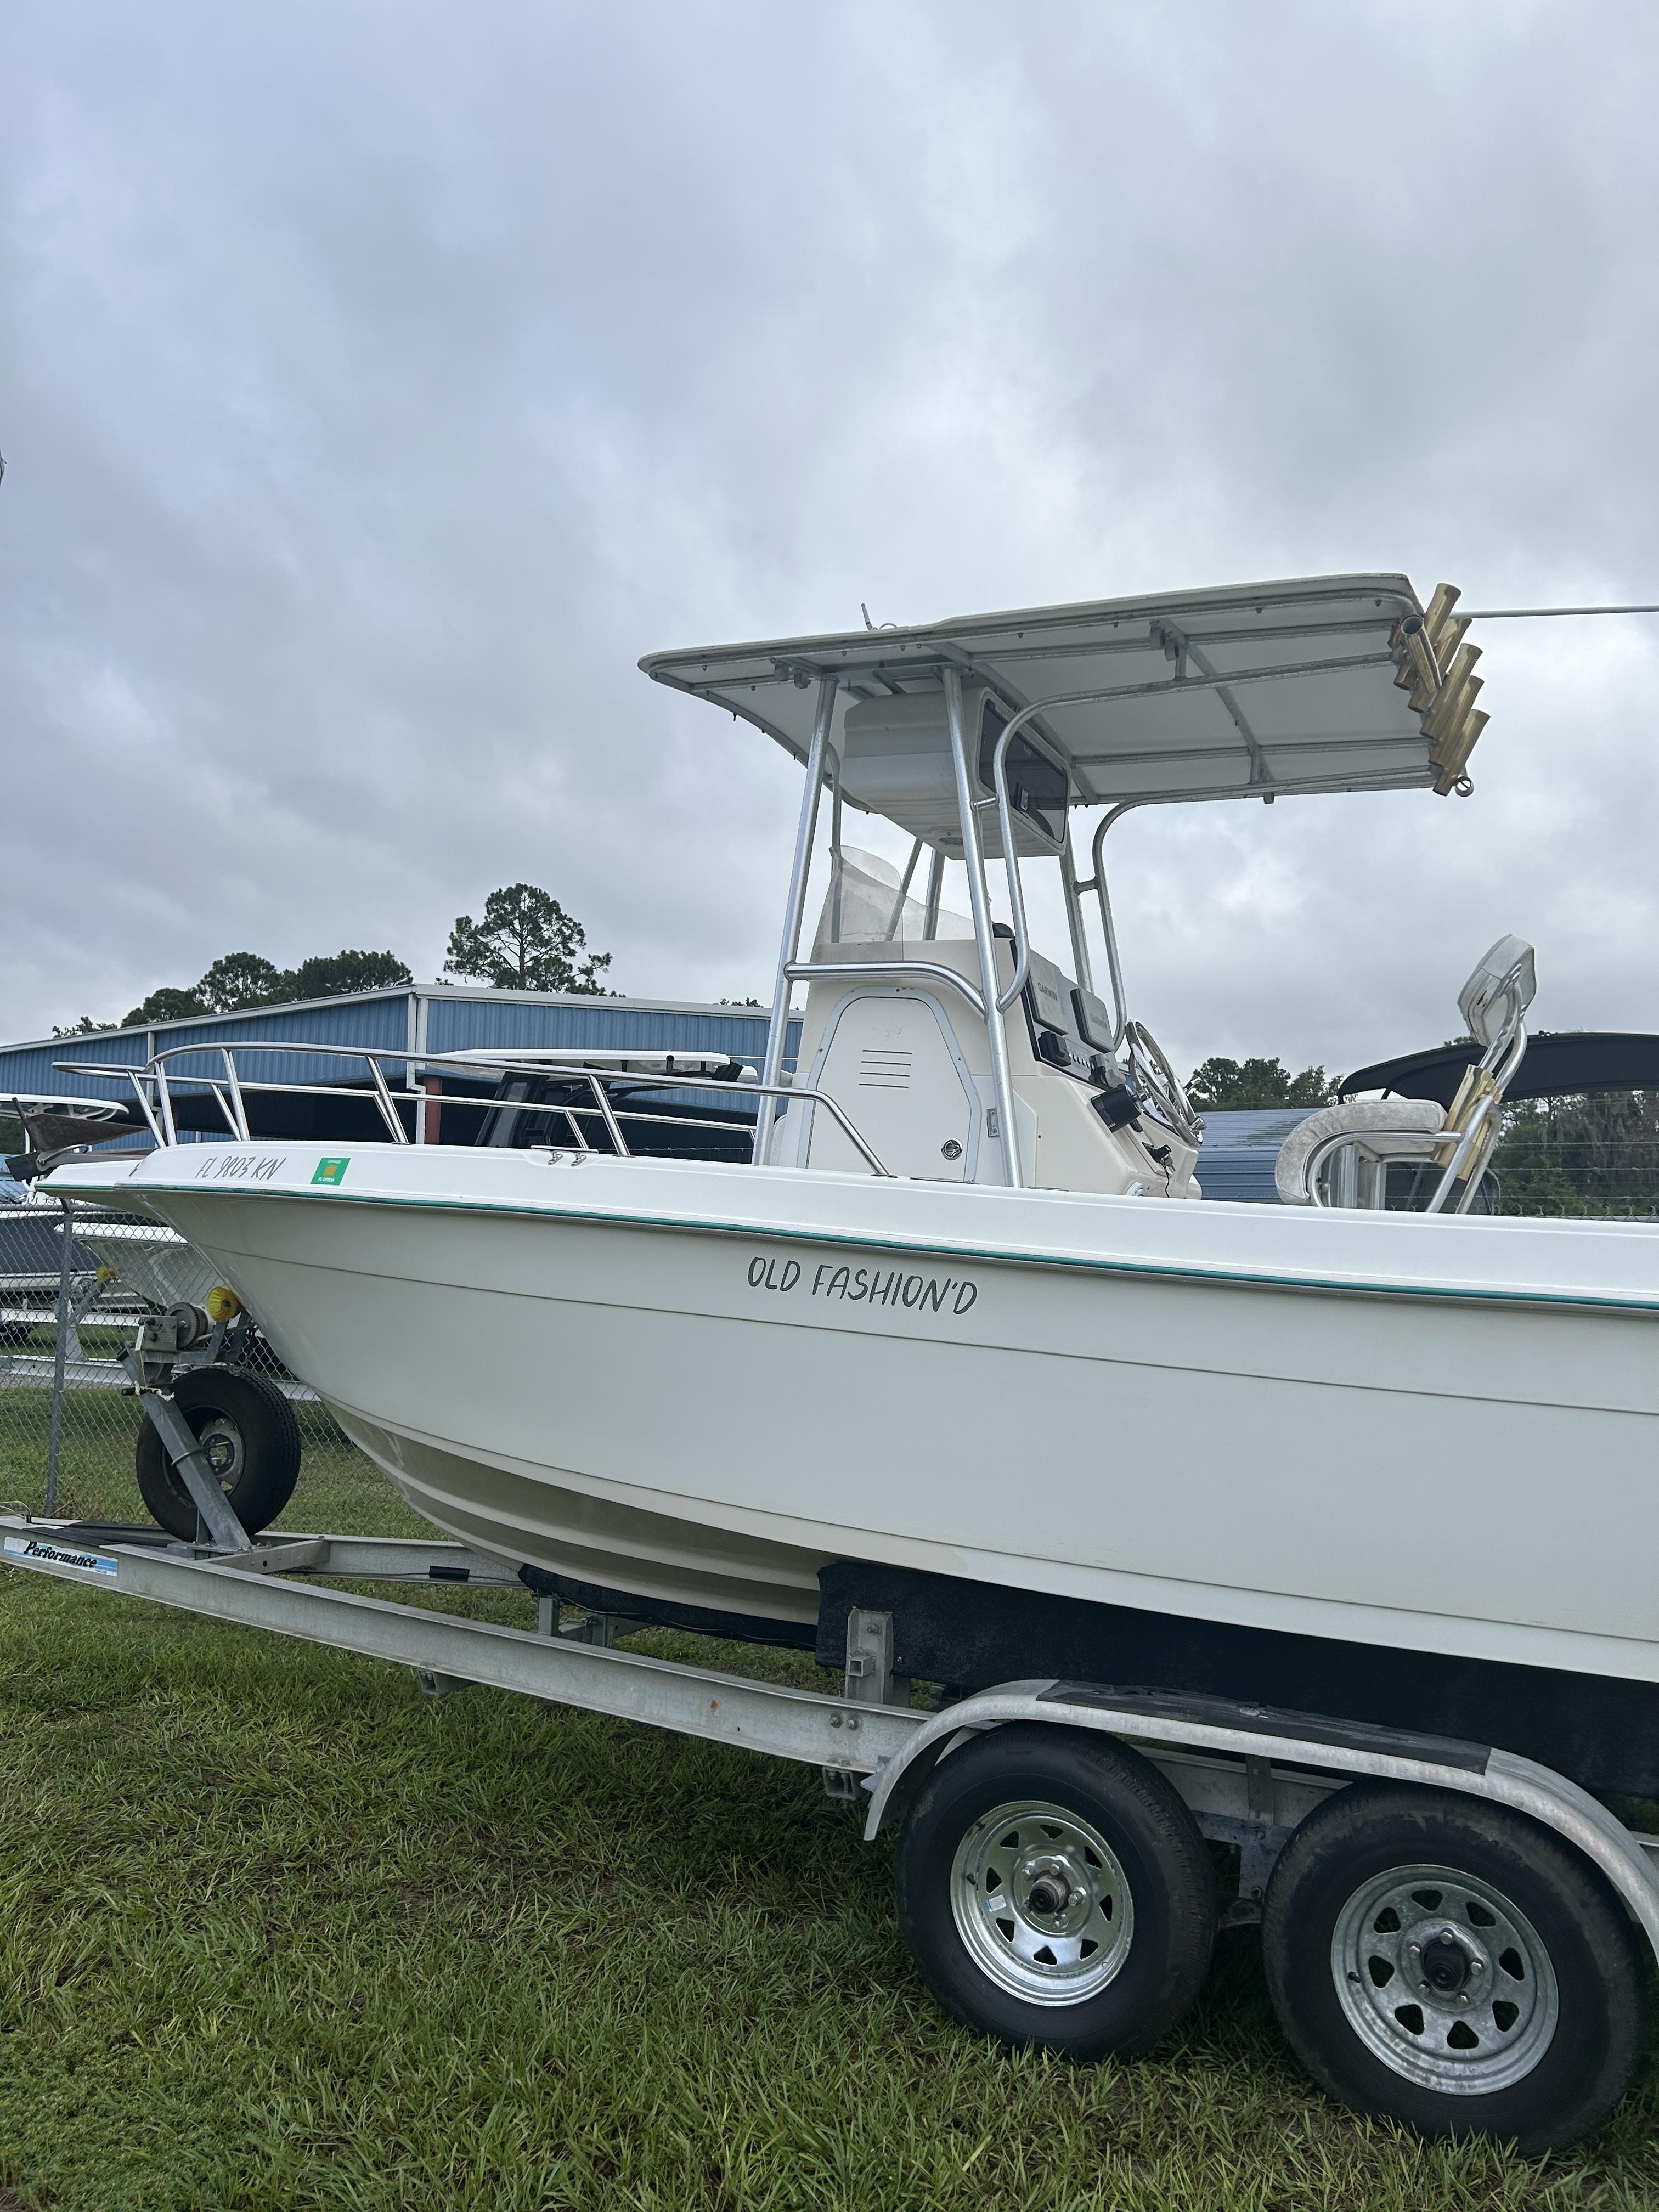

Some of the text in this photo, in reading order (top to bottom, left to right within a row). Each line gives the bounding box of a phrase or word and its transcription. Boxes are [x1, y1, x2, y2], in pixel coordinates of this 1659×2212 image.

[1037, 982, 1058, 1002] GARMIN
[195, 1155, 286, 1180] FL 9803 KN
[748, 1257, 977, 1314] OLD FASHION'D
[23, 1541, 98, 1568] Performance
